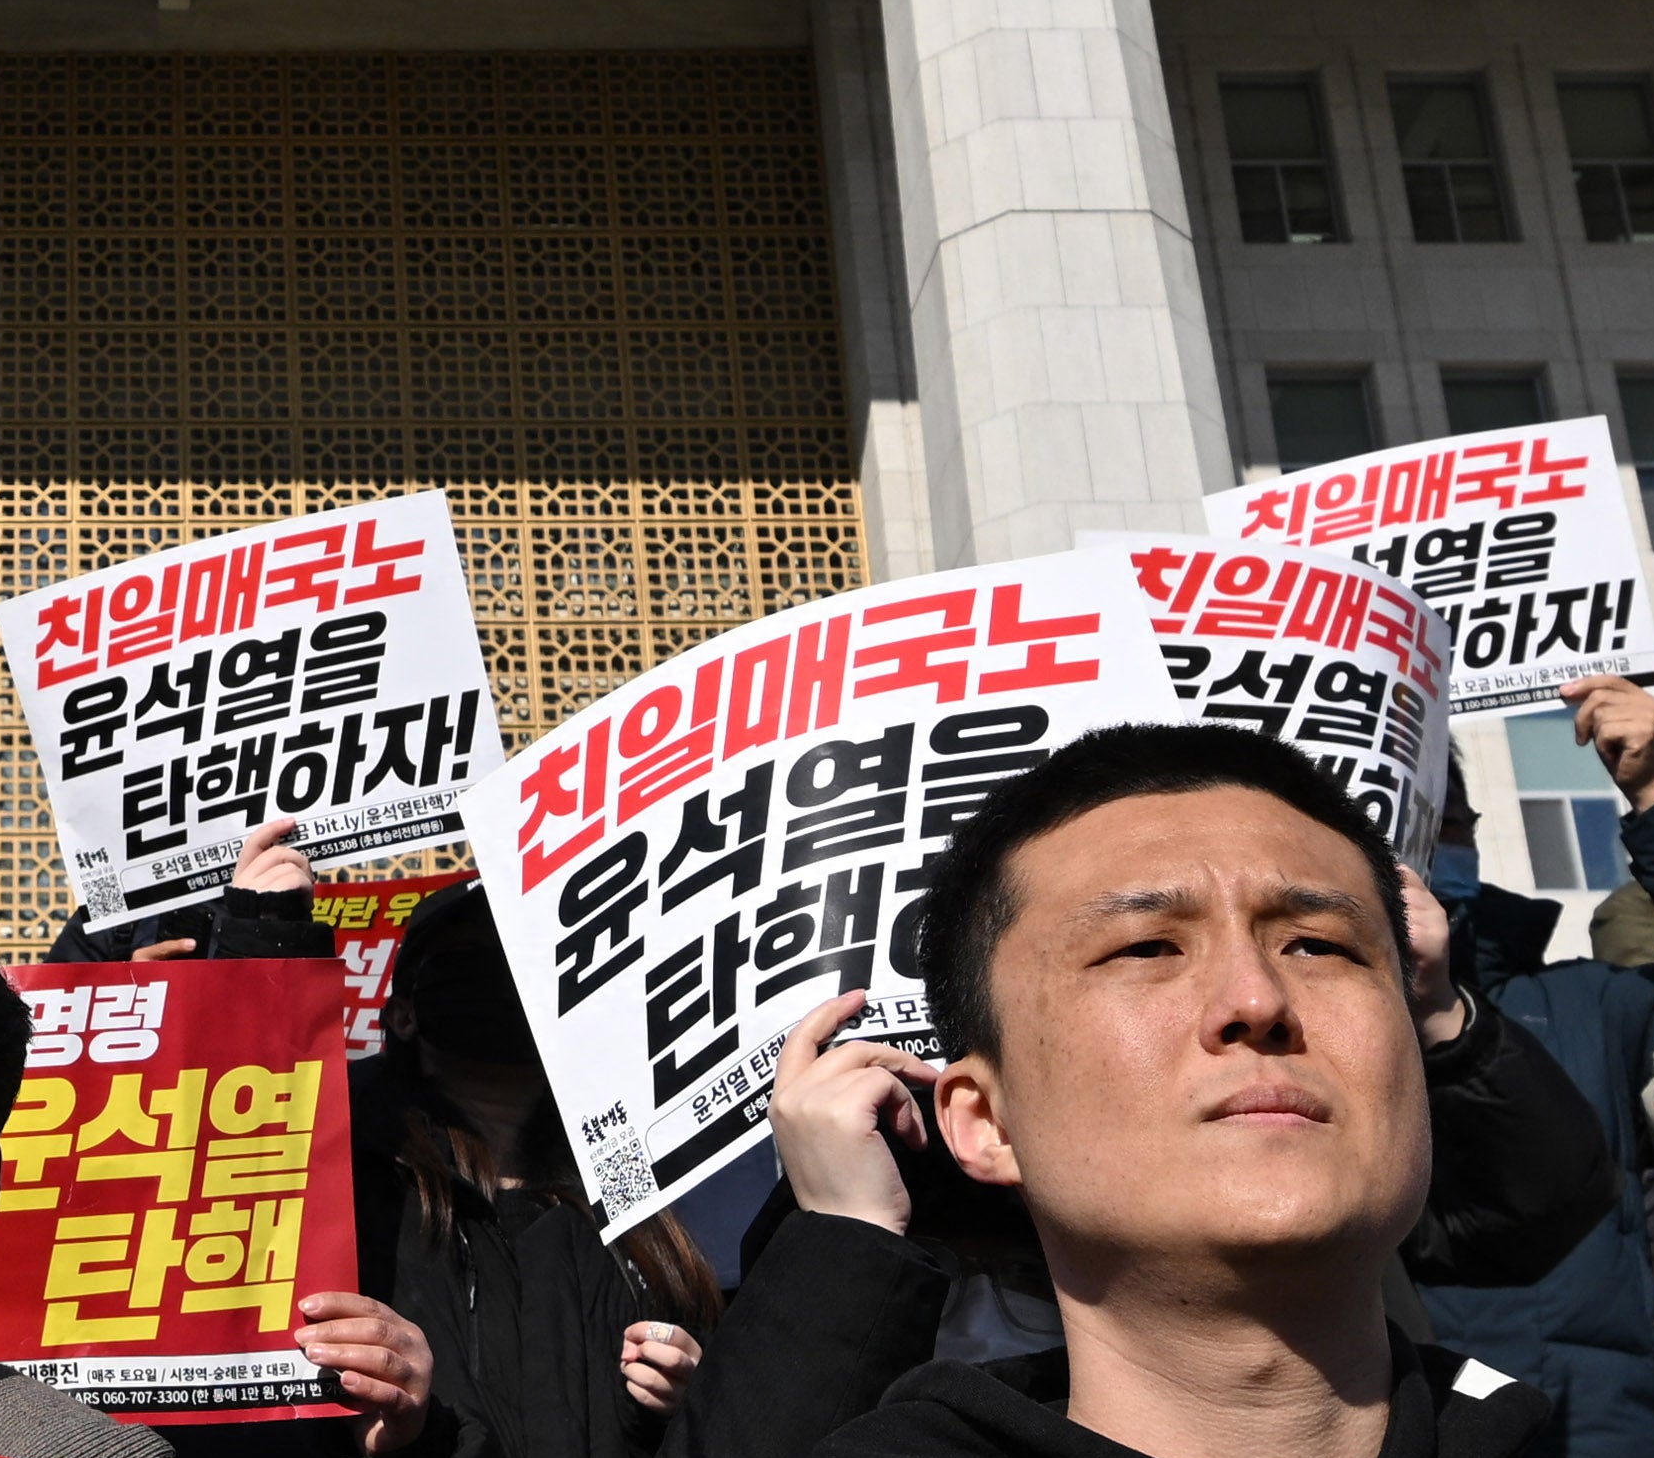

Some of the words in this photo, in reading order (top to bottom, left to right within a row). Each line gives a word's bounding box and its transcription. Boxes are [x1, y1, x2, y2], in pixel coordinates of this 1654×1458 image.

[1240, 437, 1590, 546] 친일매국노
[35, 518, 426, 690] 친일매국노
[1132, 547, 1442, 700] 친일매국노
[1450, 577, 1637, 674] 하자!
[60, 610, 388, 781] 윤석열을
[1465, 679, 1491, 693] 모금
[1495, 657, 1631, 689] bit.ly/윤석열탄핵기금
[123, 689, 480, 861] 탄핵하자!
[517, 584, 1100, 896] 친일매국노
[151, 854, 191, 881] 윤석열
[314, 789, 466, 837] bit.ly/윤석열탄핵기
[555, 704, 1051, 1018] 윤석열을
[384, 890, 437, 927] 우
[20, 981, 169, 1069] 명령
[581, 1099, 628, 1146] 촛불행동
[692, 1065, 751, 1125] 윤석열
[41, 1197, 305, 1348] 탄핵
[76, 1391, 100, 1405] ARS
[102, 1390, 189, 1405] 060-707-3300
[191, 1389, 211, 1406] (한
[240, 1387, 260, 1402] 1만
[262, 1386, 280, 1403] 원,
[281, 1384, 306, 1401] 여러
[309, 1383, 323, 1398] 번
[87, 1367, 116, 1385] (매주
[119, 1366, 157, 1383] 토요일
[160, 1366, 166, 1383] /
[169, 1361, 248, 1382] 시청역-숭례문
[251, 1363, 262, 1379] 앞
[266, 1361, 296, 1378] 대로)
